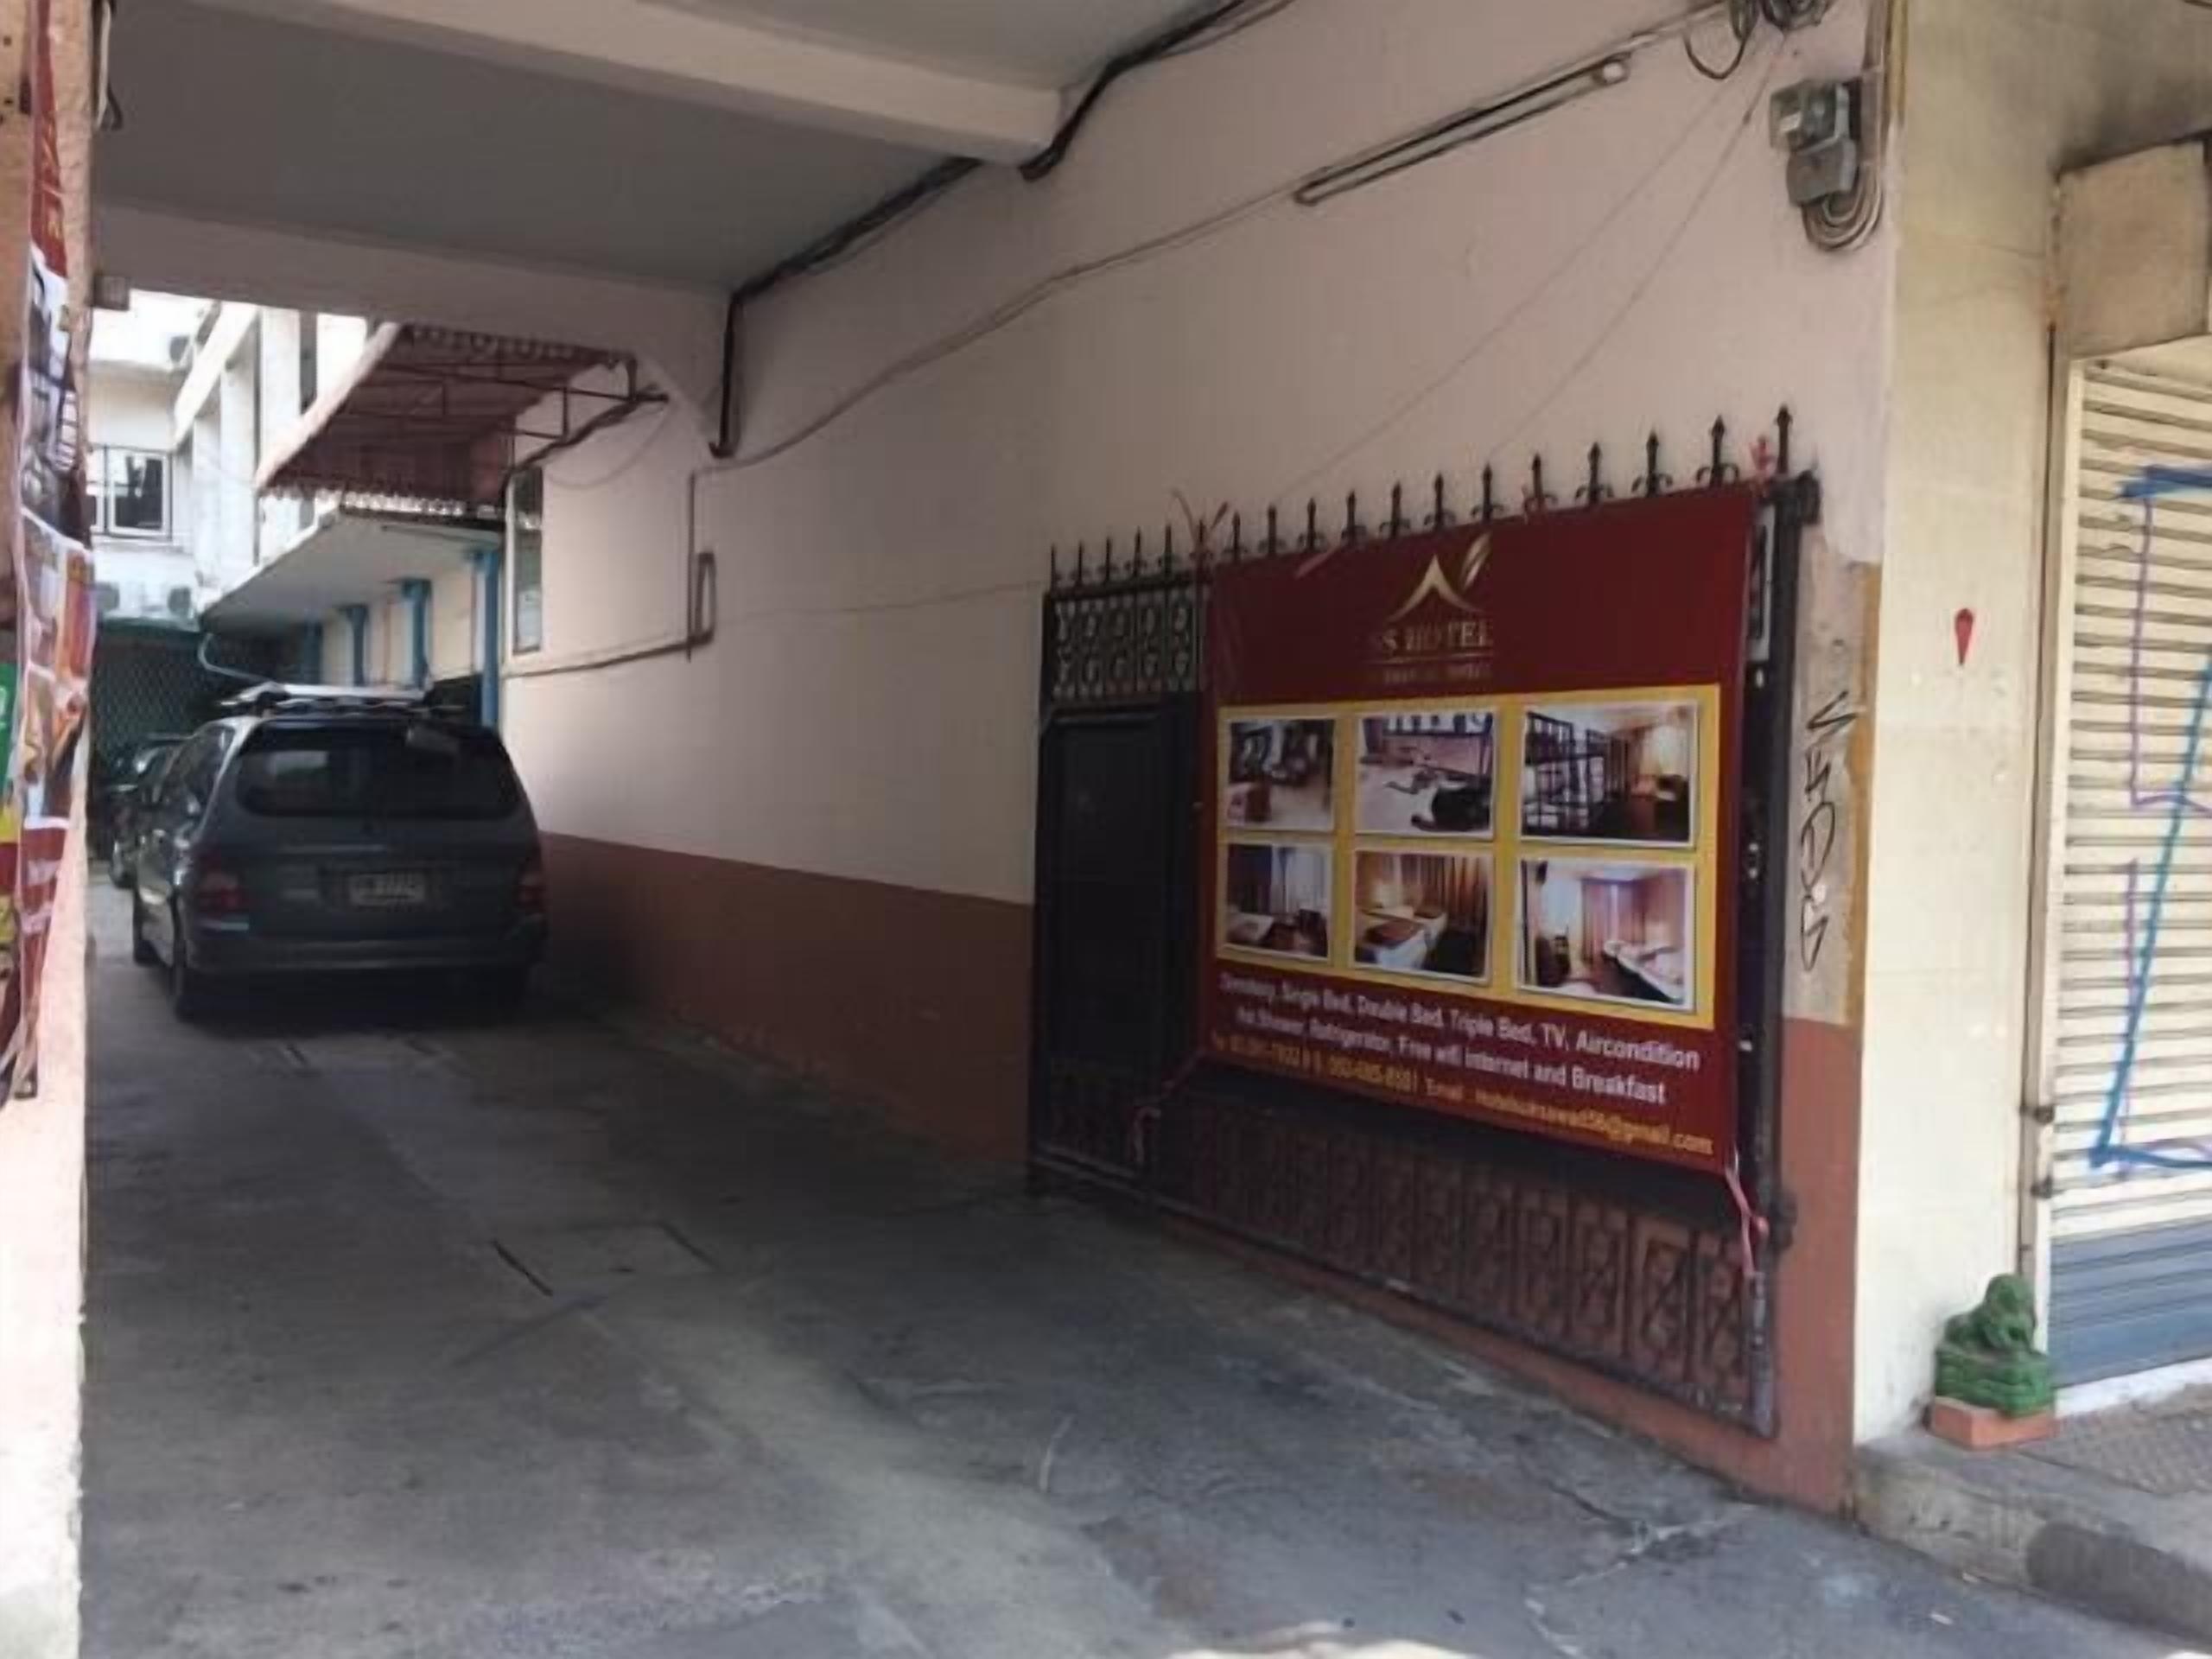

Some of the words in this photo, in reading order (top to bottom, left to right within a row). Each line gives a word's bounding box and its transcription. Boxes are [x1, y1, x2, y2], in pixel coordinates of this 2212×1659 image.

[1404, 620, 1493, 652] HOTEL
[1449, 1008, 1493, 1039] Triple
[1575, 1029, 1700, 1071] Aircondition
[1534, 1062, 1566, 1086] and
[1572, 1065, 1665, 1104] Breakfast
